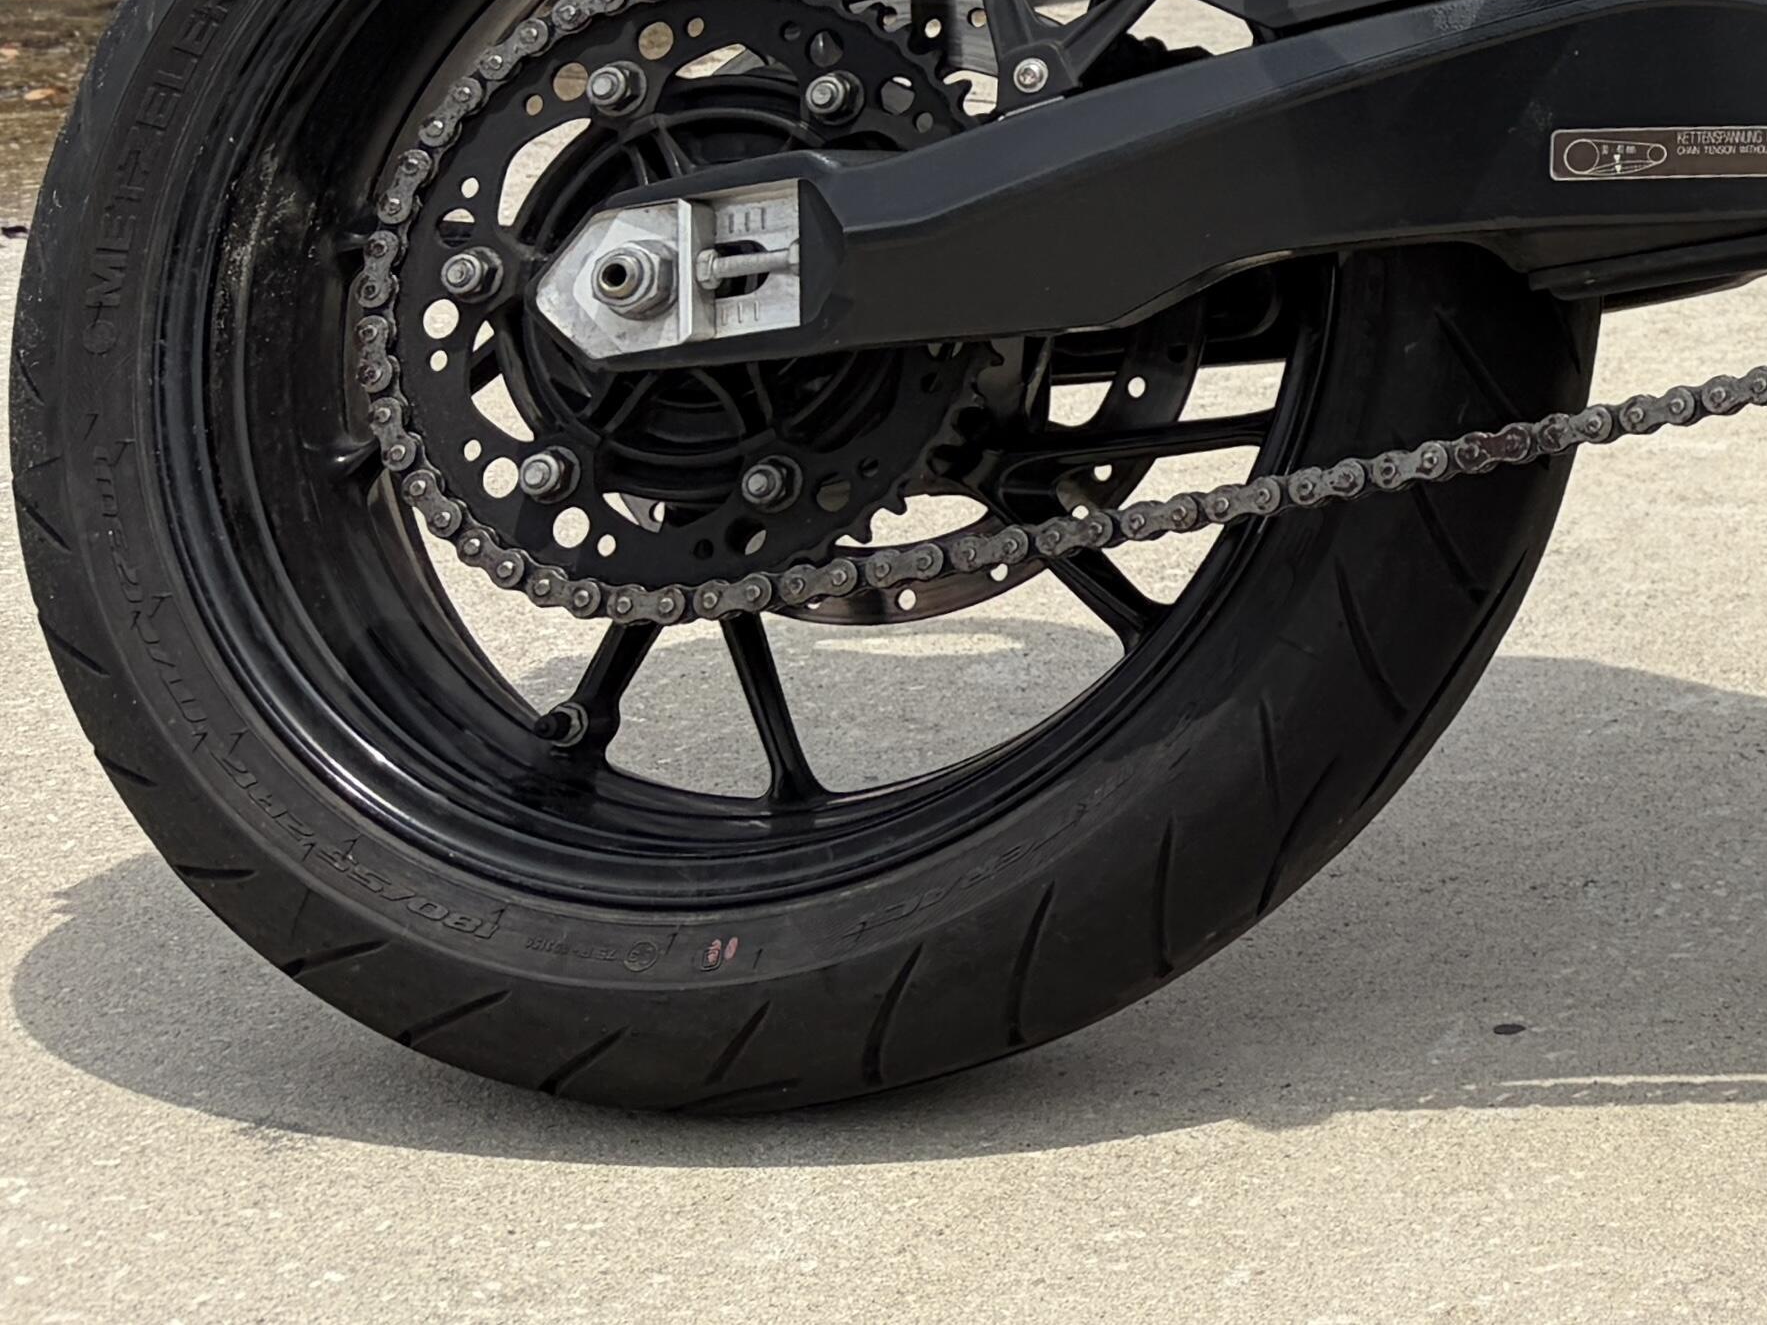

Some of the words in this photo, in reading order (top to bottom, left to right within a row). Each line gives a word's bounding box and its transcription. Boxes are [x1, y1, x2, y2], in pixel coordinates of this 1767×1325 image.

[1676, 130, 1764, 146] KETTENSPANNUNG
[1704, 145, 1737, 155] TENSION
[313, 837, 500, 946] 180/55
